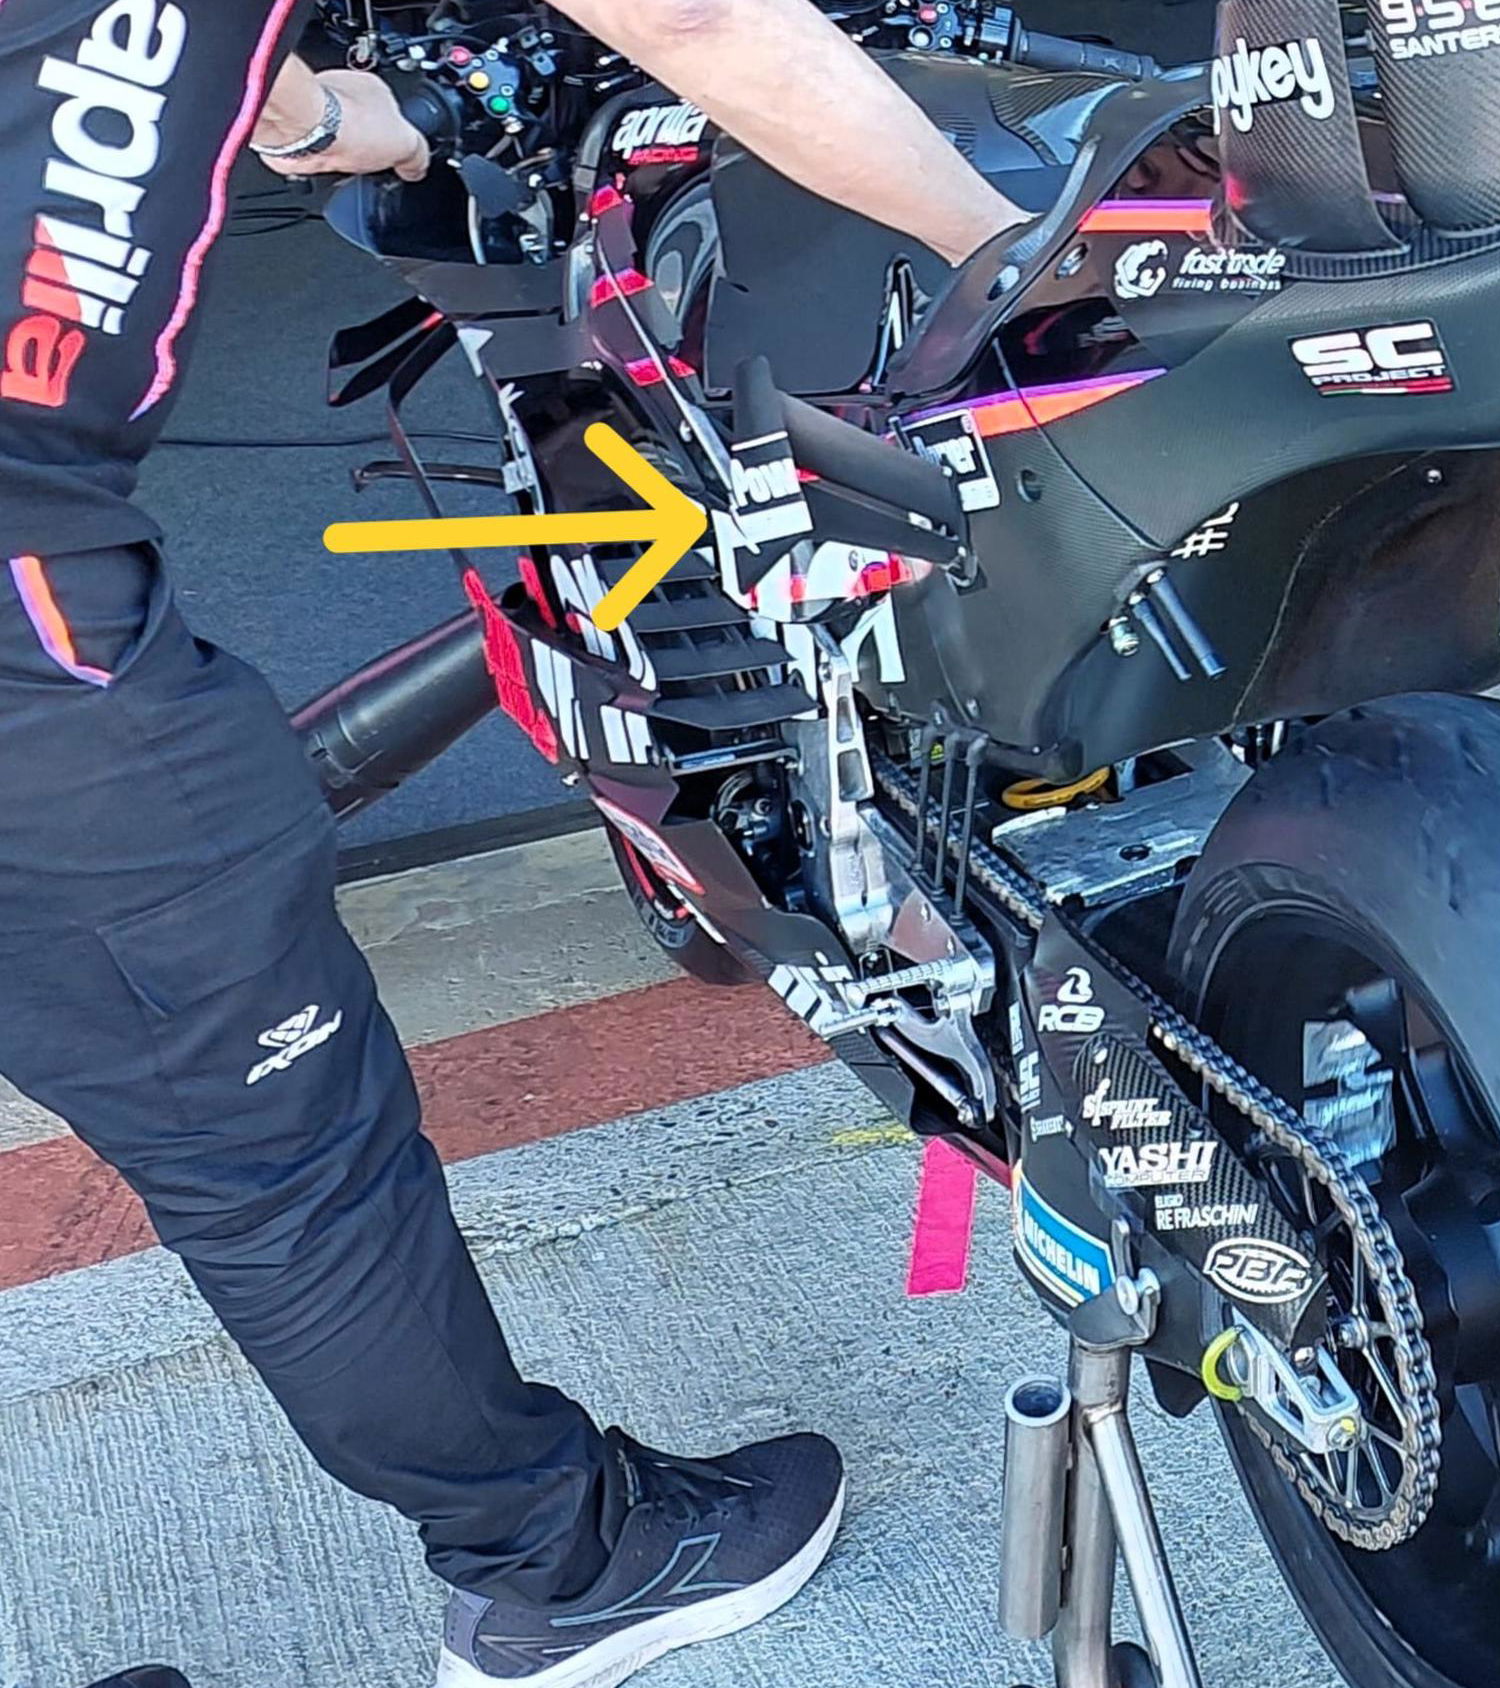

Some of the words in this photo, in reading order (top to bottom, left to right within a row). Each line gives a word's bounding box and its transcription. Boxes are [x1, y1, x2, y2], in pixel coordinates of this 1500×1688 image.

[612, 98, 708, 160] aprilia
[0, 0, 190, 408] aprilia
[1292, 322, 1443, 377] SC
[1310, 364, 1446, 385] PROJECT
[1038, 1004, 1105, 1033] RCB
[1099, 1142, 1218, 1178] YASHI
[1174, 1203, 1259, 1229] FRASCHINI
[1023, 1208, 1101, 1295] MICHELIN
